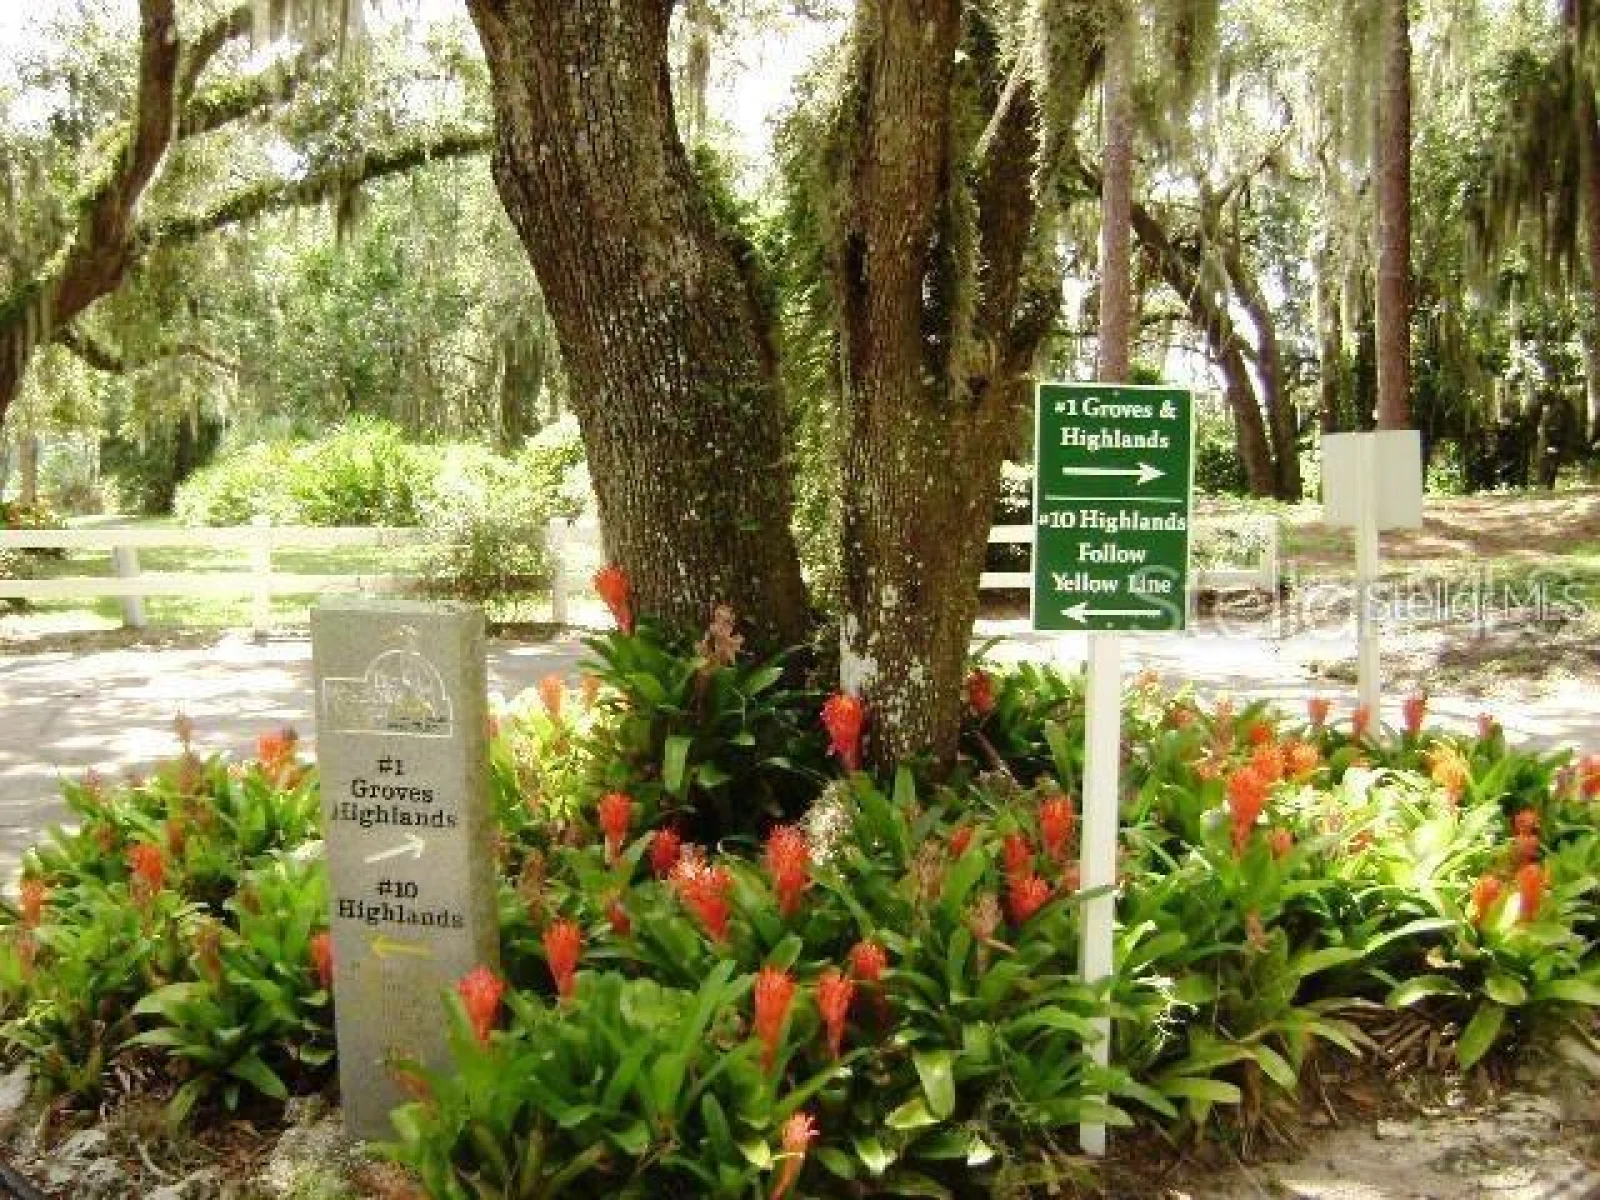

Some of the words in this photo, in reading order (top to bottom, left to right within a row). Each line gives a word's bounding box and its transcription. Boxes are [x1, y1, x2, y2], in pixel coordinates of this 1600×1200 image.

[1054, 398, 1079, 416] #1
[1081, 397, 1153, 419] Groves
[1159, 399, 1179, 420] &
[1059, 426, 1170, 451] Highlands
[1038, 510, 1076, 529] #10
[1079, 509, 1186, 533] Highlands
[1078, 541, 1147, 563] Follow
[1051, 572, 1118, 593] Yellow
[1127, 573, 1172, 594] Line
[376, 755, 406, 776] #1
[351, 778, 434, 804] Groves
[330, 801, 459, 829] Highlands
[375, 878, 419, 899] #10
[338, 899, 465, 929] Highlands
